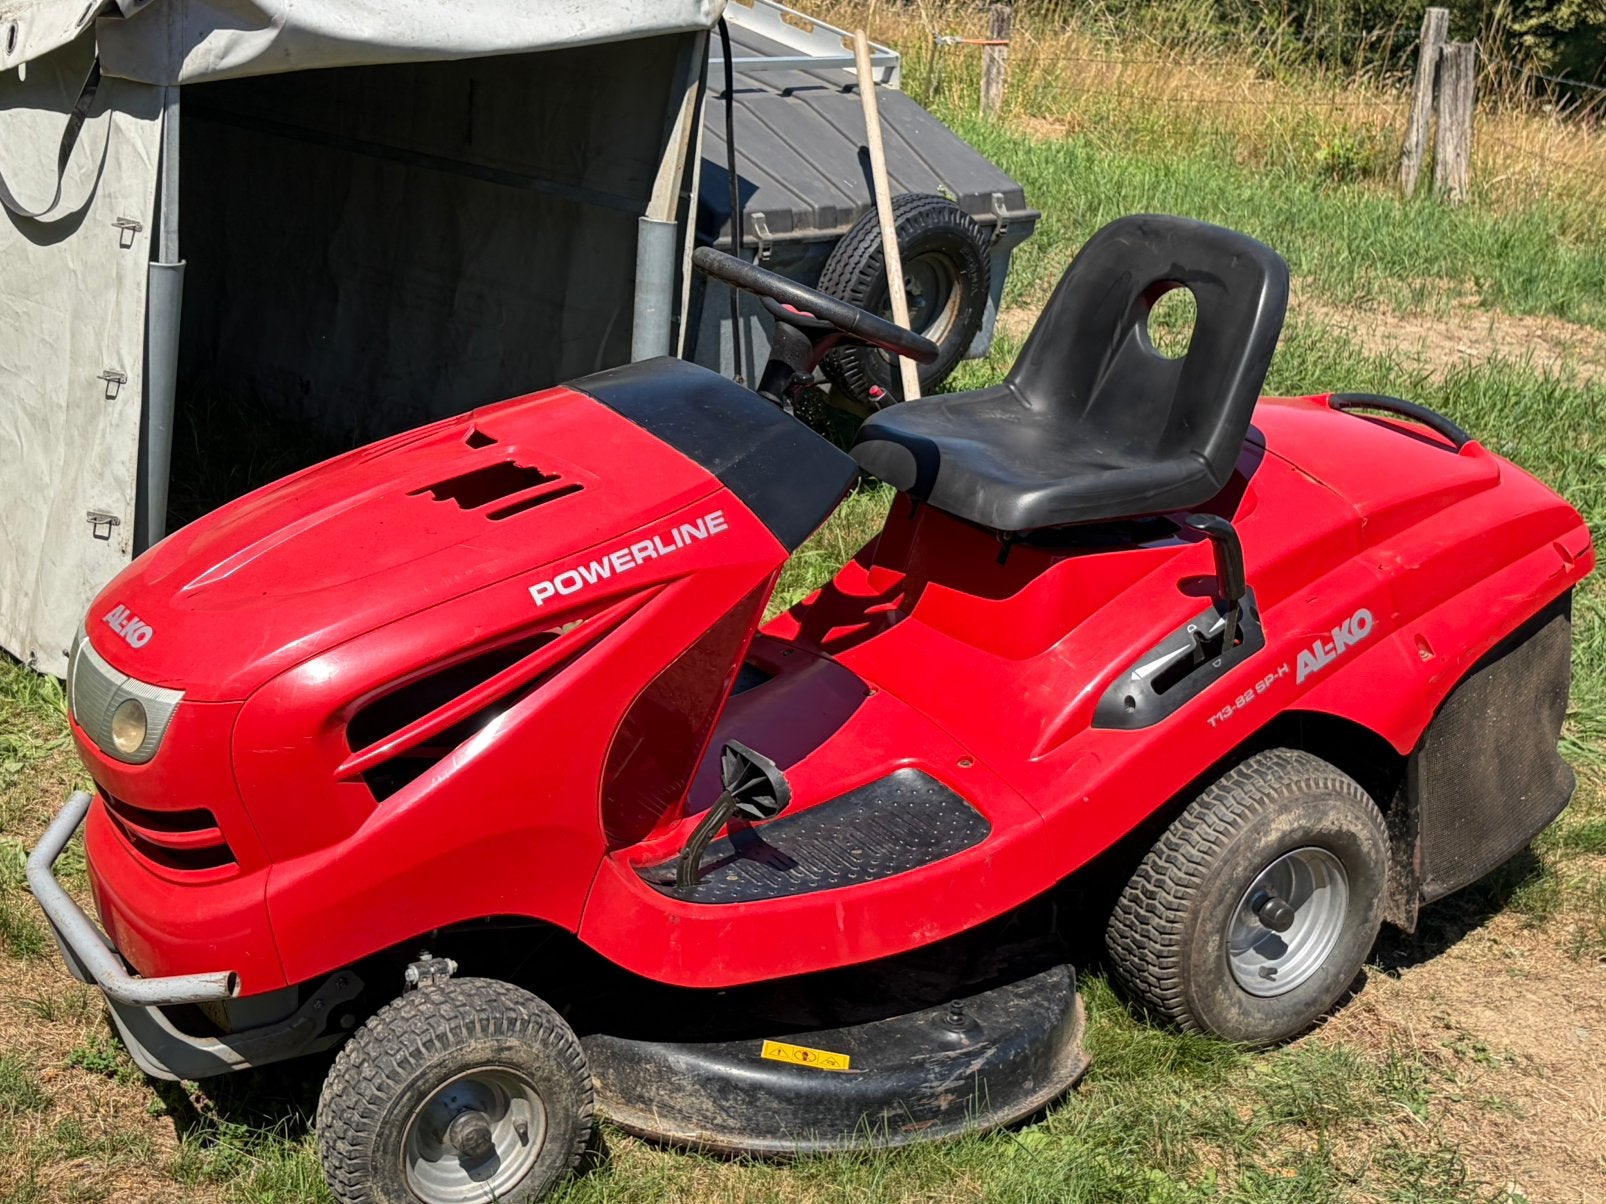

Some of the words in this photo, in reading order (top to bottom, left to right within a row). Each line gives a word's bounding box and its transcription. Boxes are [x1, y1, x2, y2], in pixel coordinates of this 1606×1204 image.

[528, 509, 729, 607] POWERLINE
[102, 603, 153, 648] AL-KO
[1296, 608, 1374, 686] AL-KO
[1207, 689, 1256, 728] T13-82
[1255, 662, 1290, 695] SP-H
